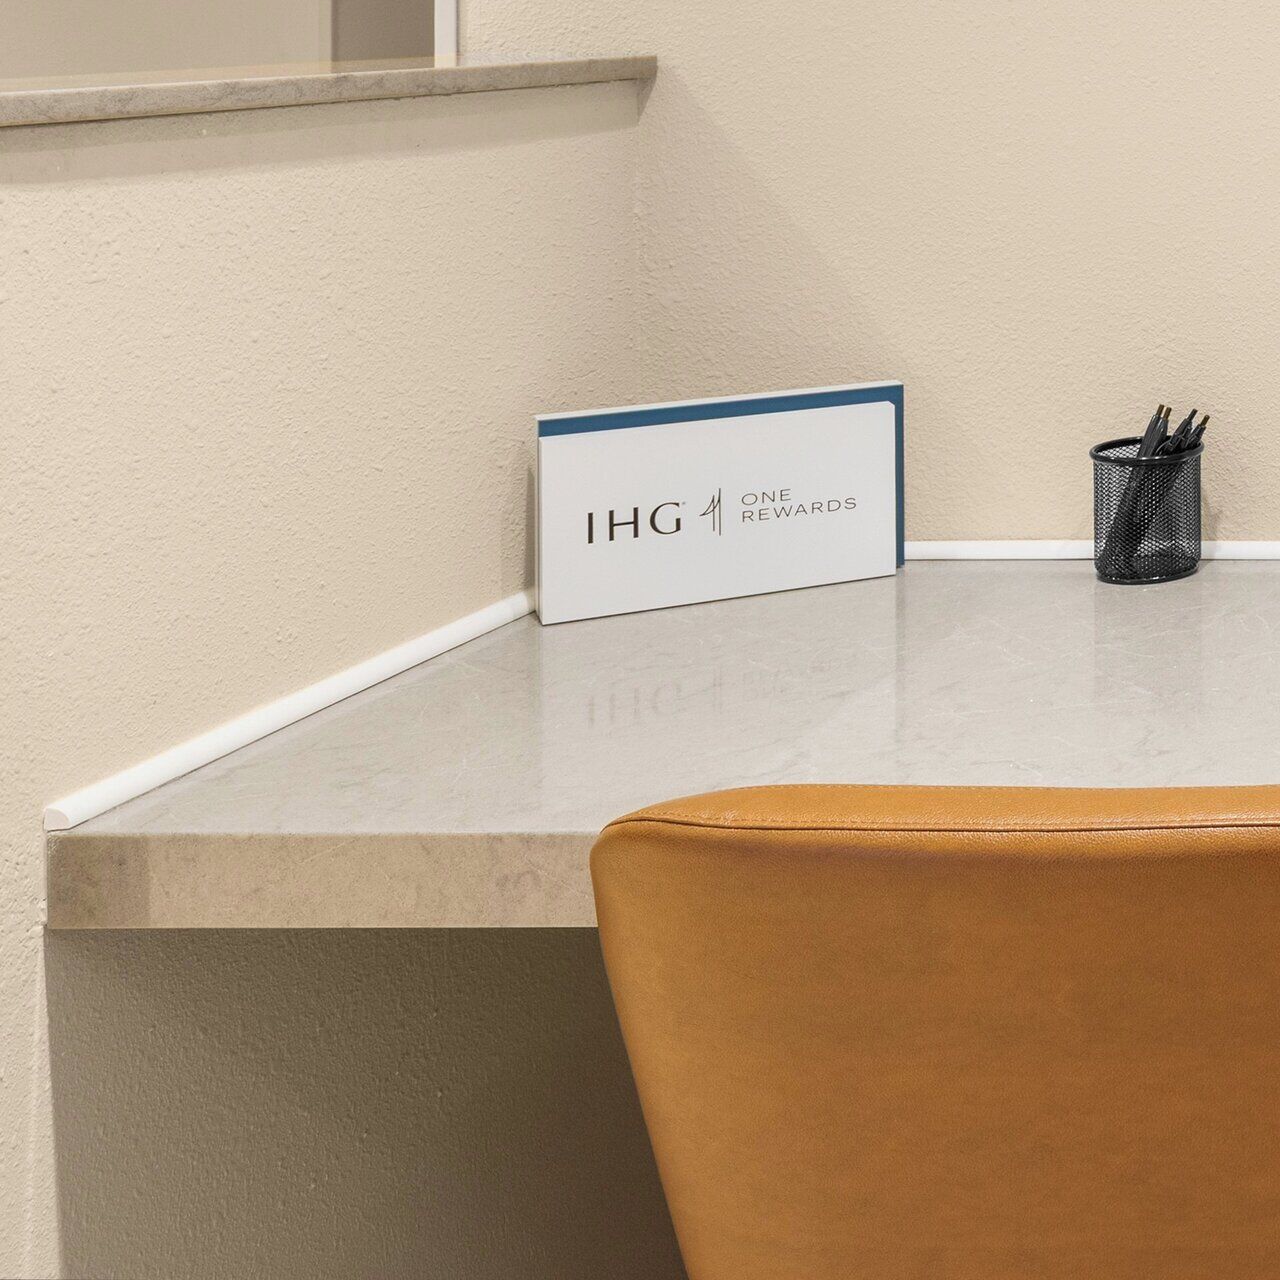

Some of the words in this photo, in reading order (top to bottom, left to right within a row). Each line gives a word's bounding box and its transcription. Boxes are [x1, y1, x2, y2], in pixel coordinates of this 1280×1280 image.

[741, 488, 792, 506] ONE
[741, 497, 858, 523] REWARDS
[587, 502, 682, 544] IHG
